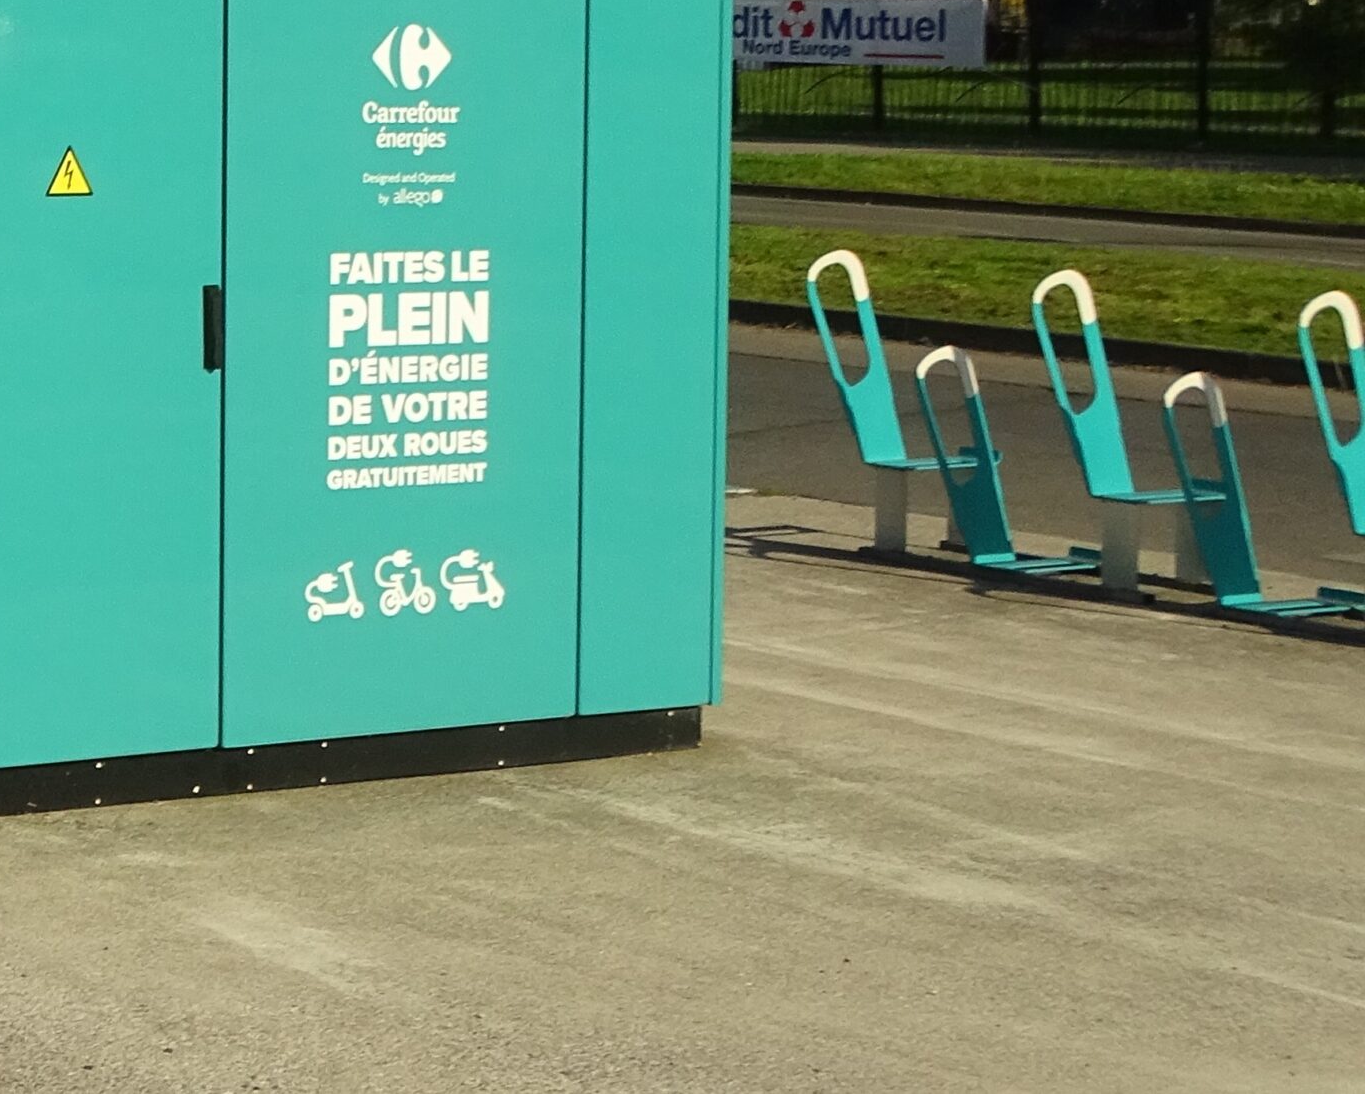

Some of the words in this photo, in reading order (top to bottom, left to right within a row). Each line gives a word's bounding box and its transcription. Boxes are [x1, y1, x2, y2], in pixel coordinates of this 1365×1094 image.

[733, 6, 773, 38] dit
[821, 7, 947, 42] Mutuel
[742, 39, 783, 56] Nord
[789, 40, 852, 60] Europe
[362, 100, 460, 124] Carrefour
[376, 126, 447, 155] énergies
[362, 172, 401, 186] Designed
[402, 172, 417, 183] and
[377, 193, 389, 206] by
[329, 250, 446, 285] FAITES
[451, 249, 490, 282] LE
[328, 290, 490, 348] PLEIN
[328, 394, 372, 426] DE
[381, 390, 488, 424] VOTRE
[327, 433, 398, 460] DEUX
[403, 430, 488, 457] ROUES
[326, 462, 488, 490] GRATUITEMENT
